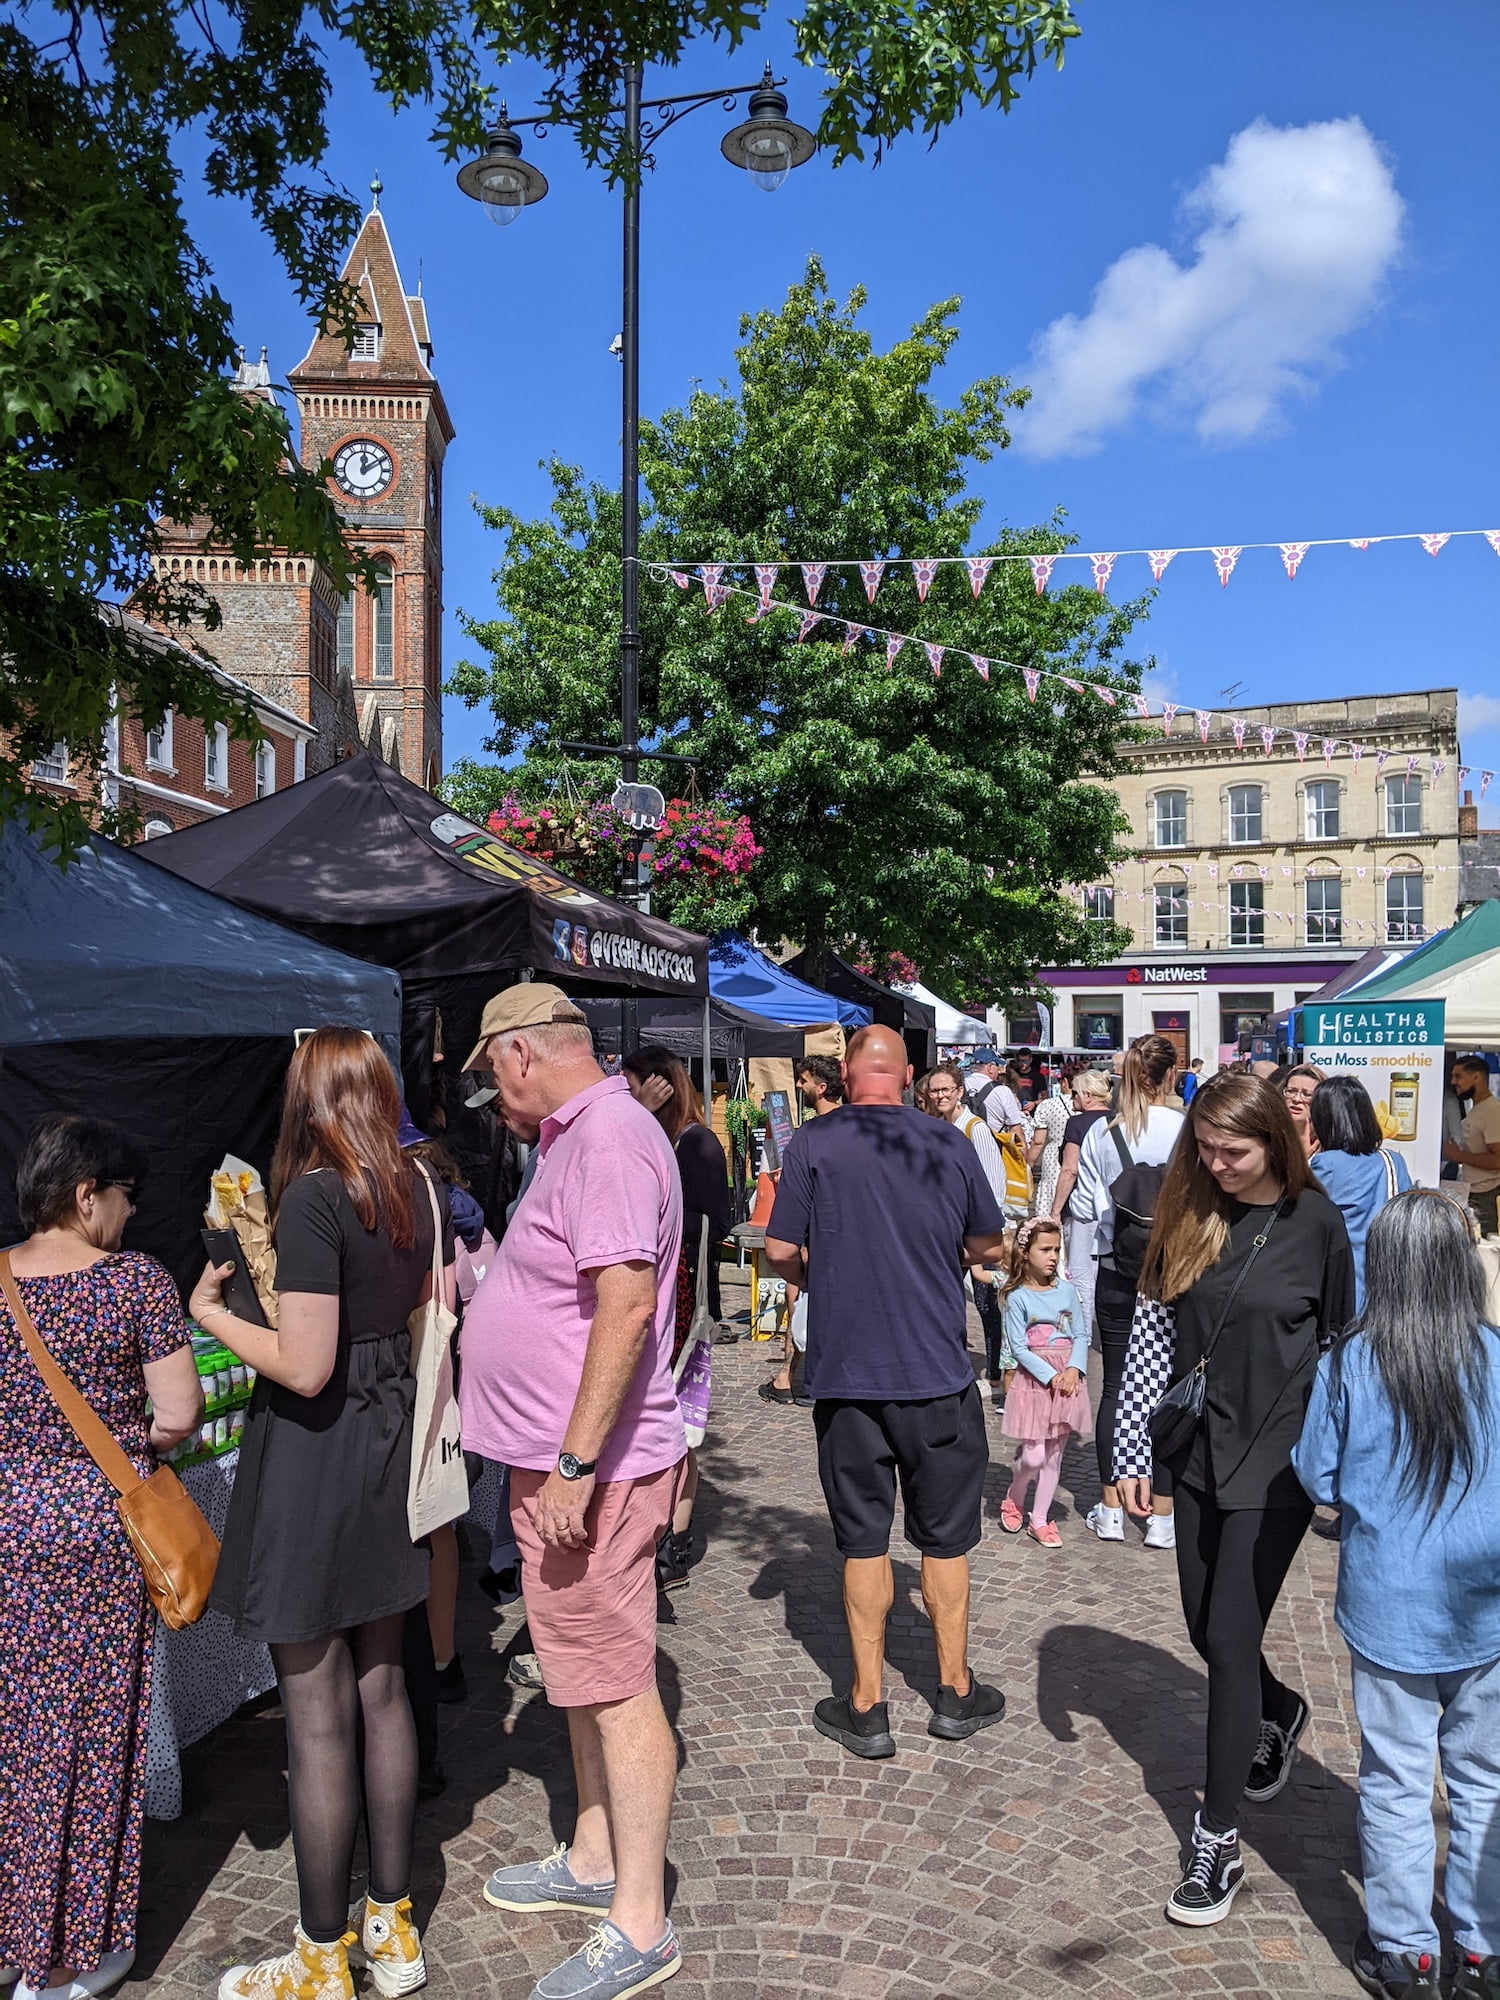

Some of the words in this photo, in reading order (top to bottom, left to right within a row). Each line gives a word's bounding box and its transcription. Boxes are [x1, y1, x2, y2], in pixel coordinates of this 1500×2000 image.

[1144, 967, 1208, 982] NatWest
[1309, 1052, 1332, 1066] Sea
[1335, 1052, 1368, 1066] Moss
[1370, 1052, 1433, 1067] smoothie
